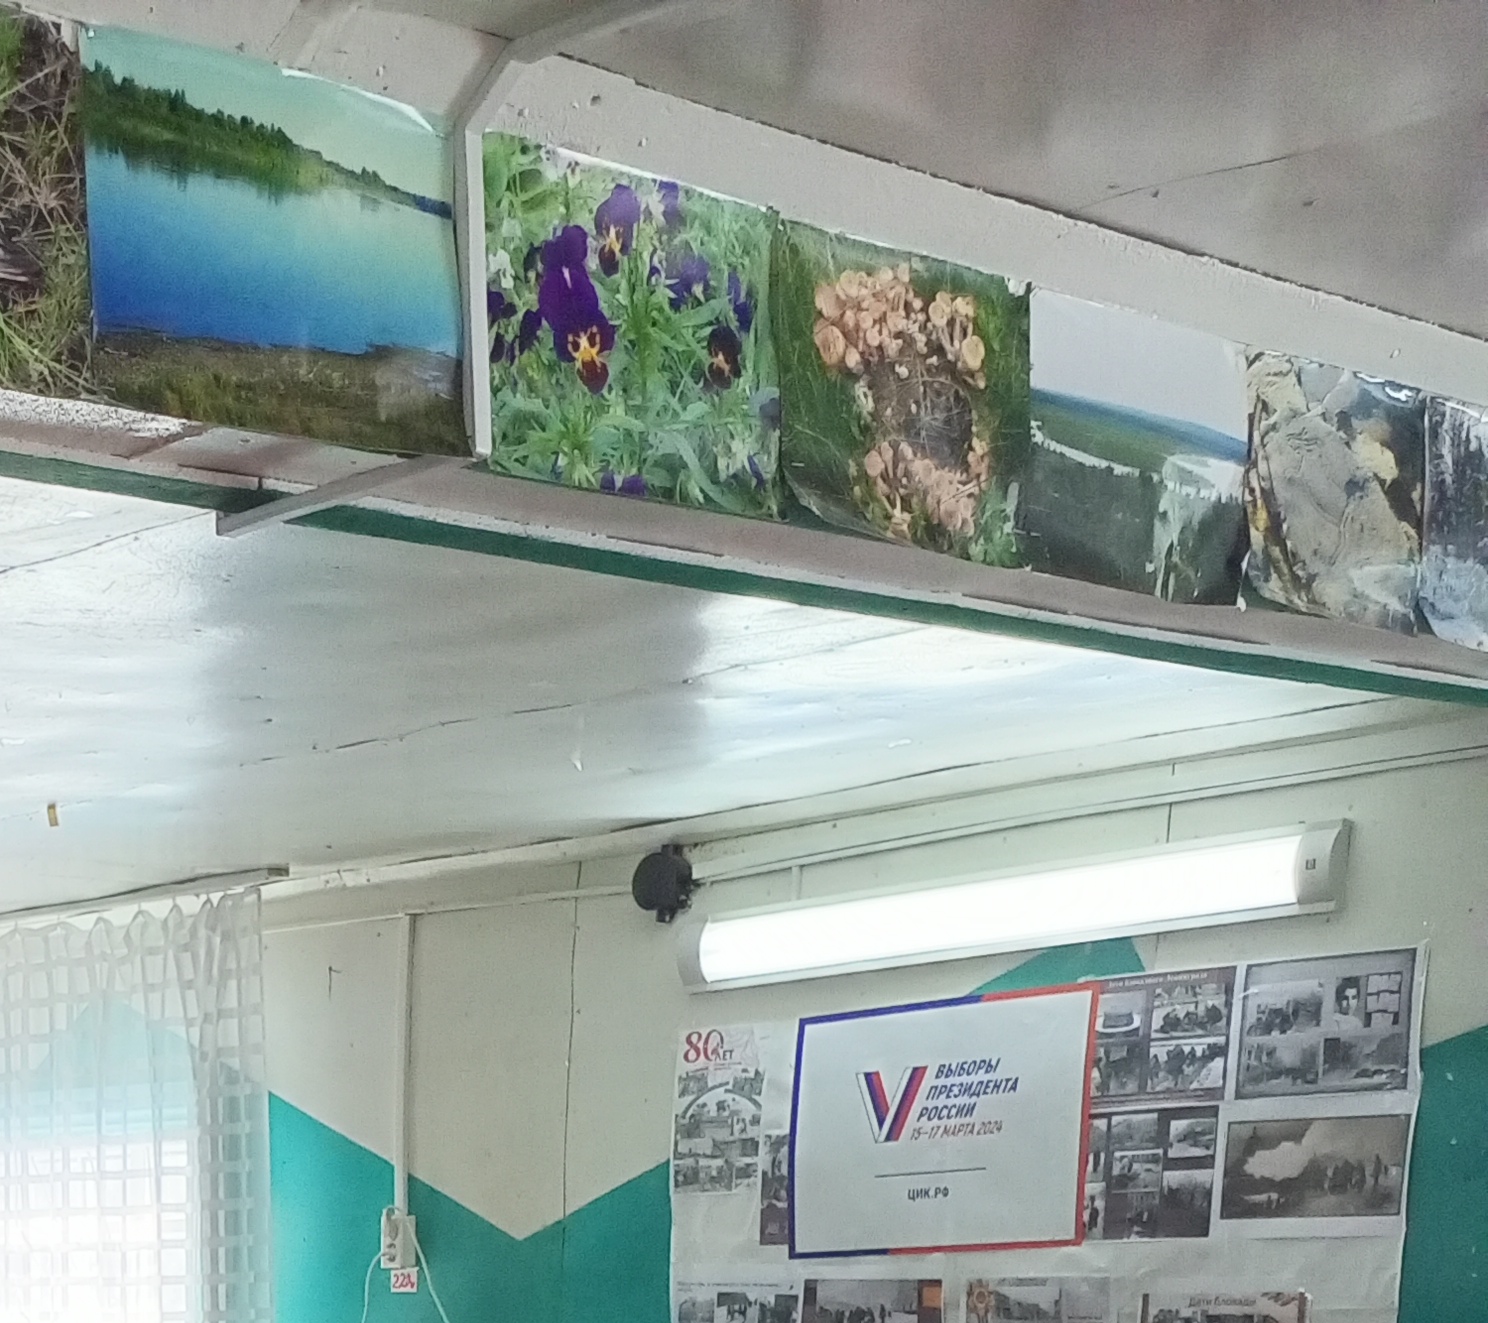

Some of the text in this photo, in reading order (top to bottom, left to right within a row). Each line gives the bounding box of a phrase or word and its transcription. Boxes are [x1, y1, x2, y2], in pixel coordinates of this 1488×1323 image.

[683, 1029, 724, 1063] 80
[935, 1057, 1001, 1079] ВЫБОРЫ
[925, 1076, 1019, 1101] ПРЕЗИДЕНТА
[916, 1101, 977, 1122] РОССИИ
[940, 1122, 975, 1138] МАРТА
[976, 1120, 1003, 1136] 2024
[907, 1186, 950, 1201] ЦИК.РФ
